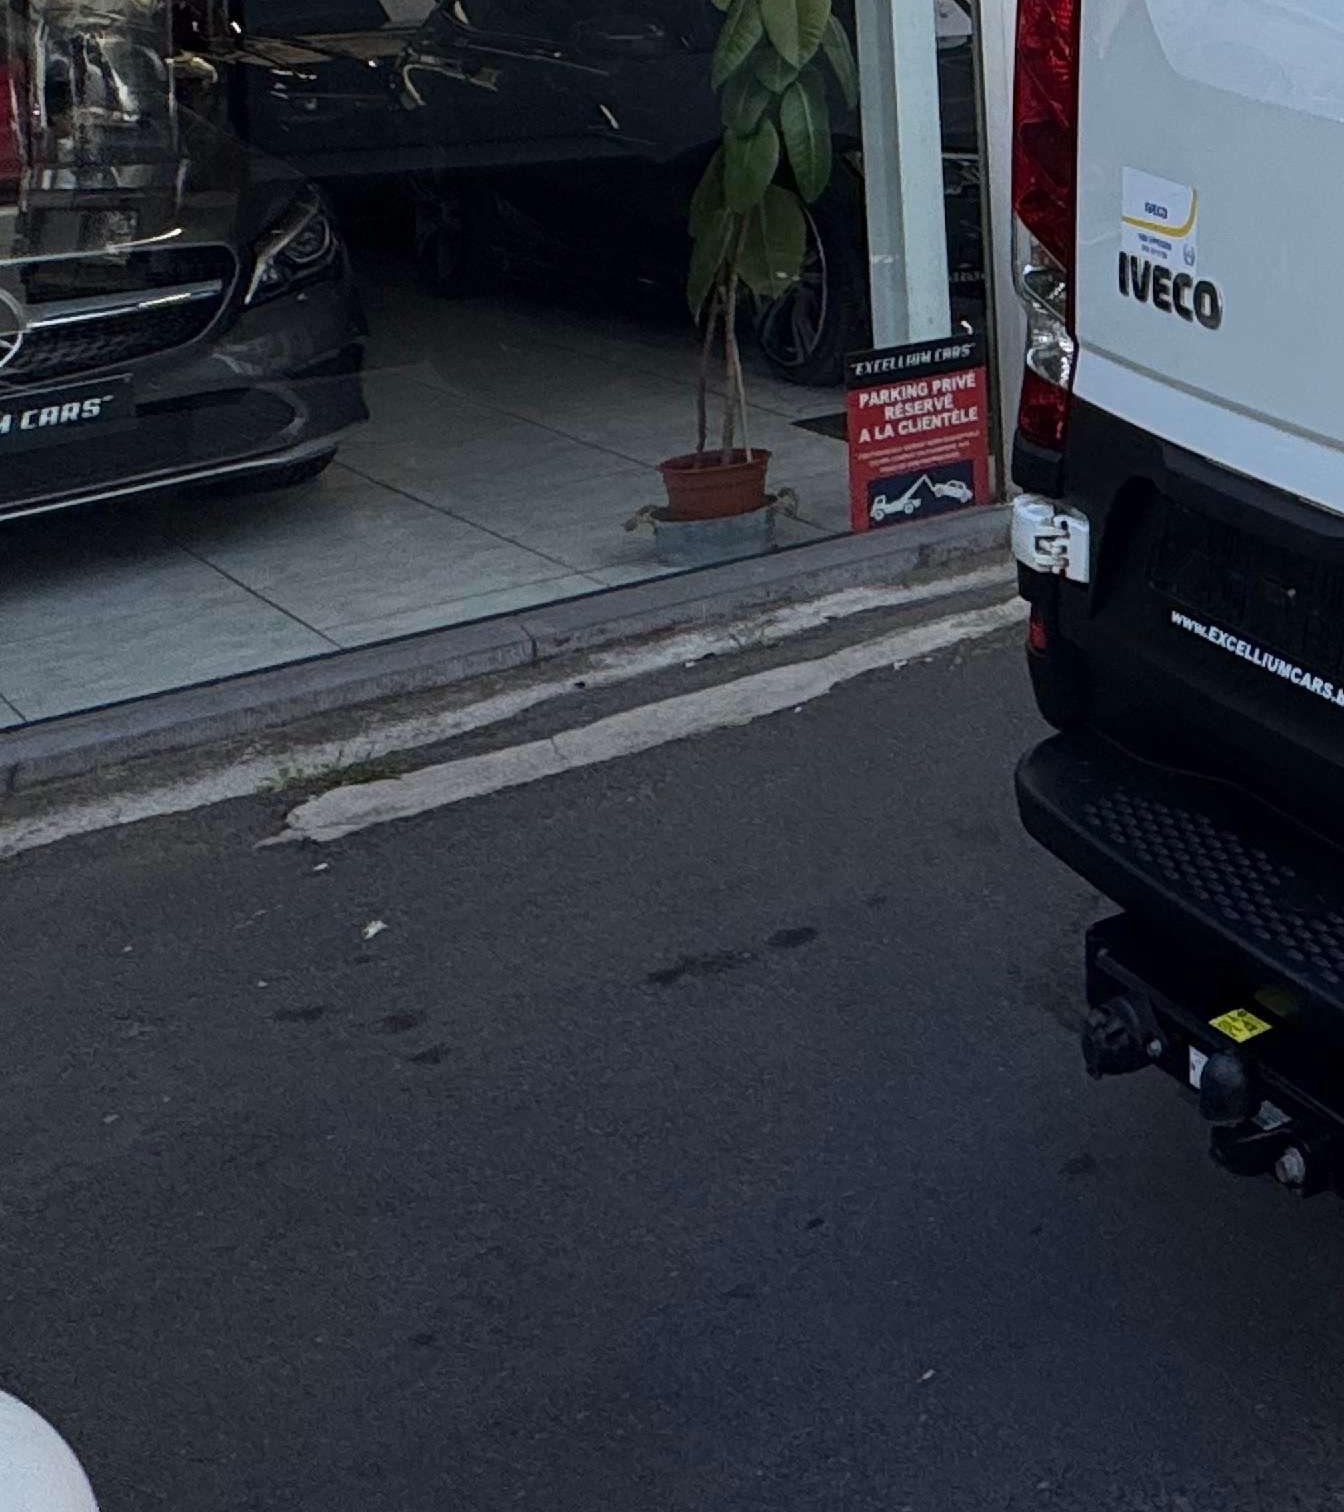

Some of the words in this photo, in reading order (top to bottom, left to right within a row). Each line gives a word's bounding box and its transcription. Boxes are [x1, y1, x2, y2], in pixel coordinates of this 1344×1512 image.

[1119, 250, 1223, 330] IVECO
[859, 382, 928, 408] PARKING
[932, 369, 976, 394] PRIVÉ
[20, 398, 102, 429] CARS
[884, 393, 954, 420] RÉSERVÉ
[874, 423, 895, 440] LA
